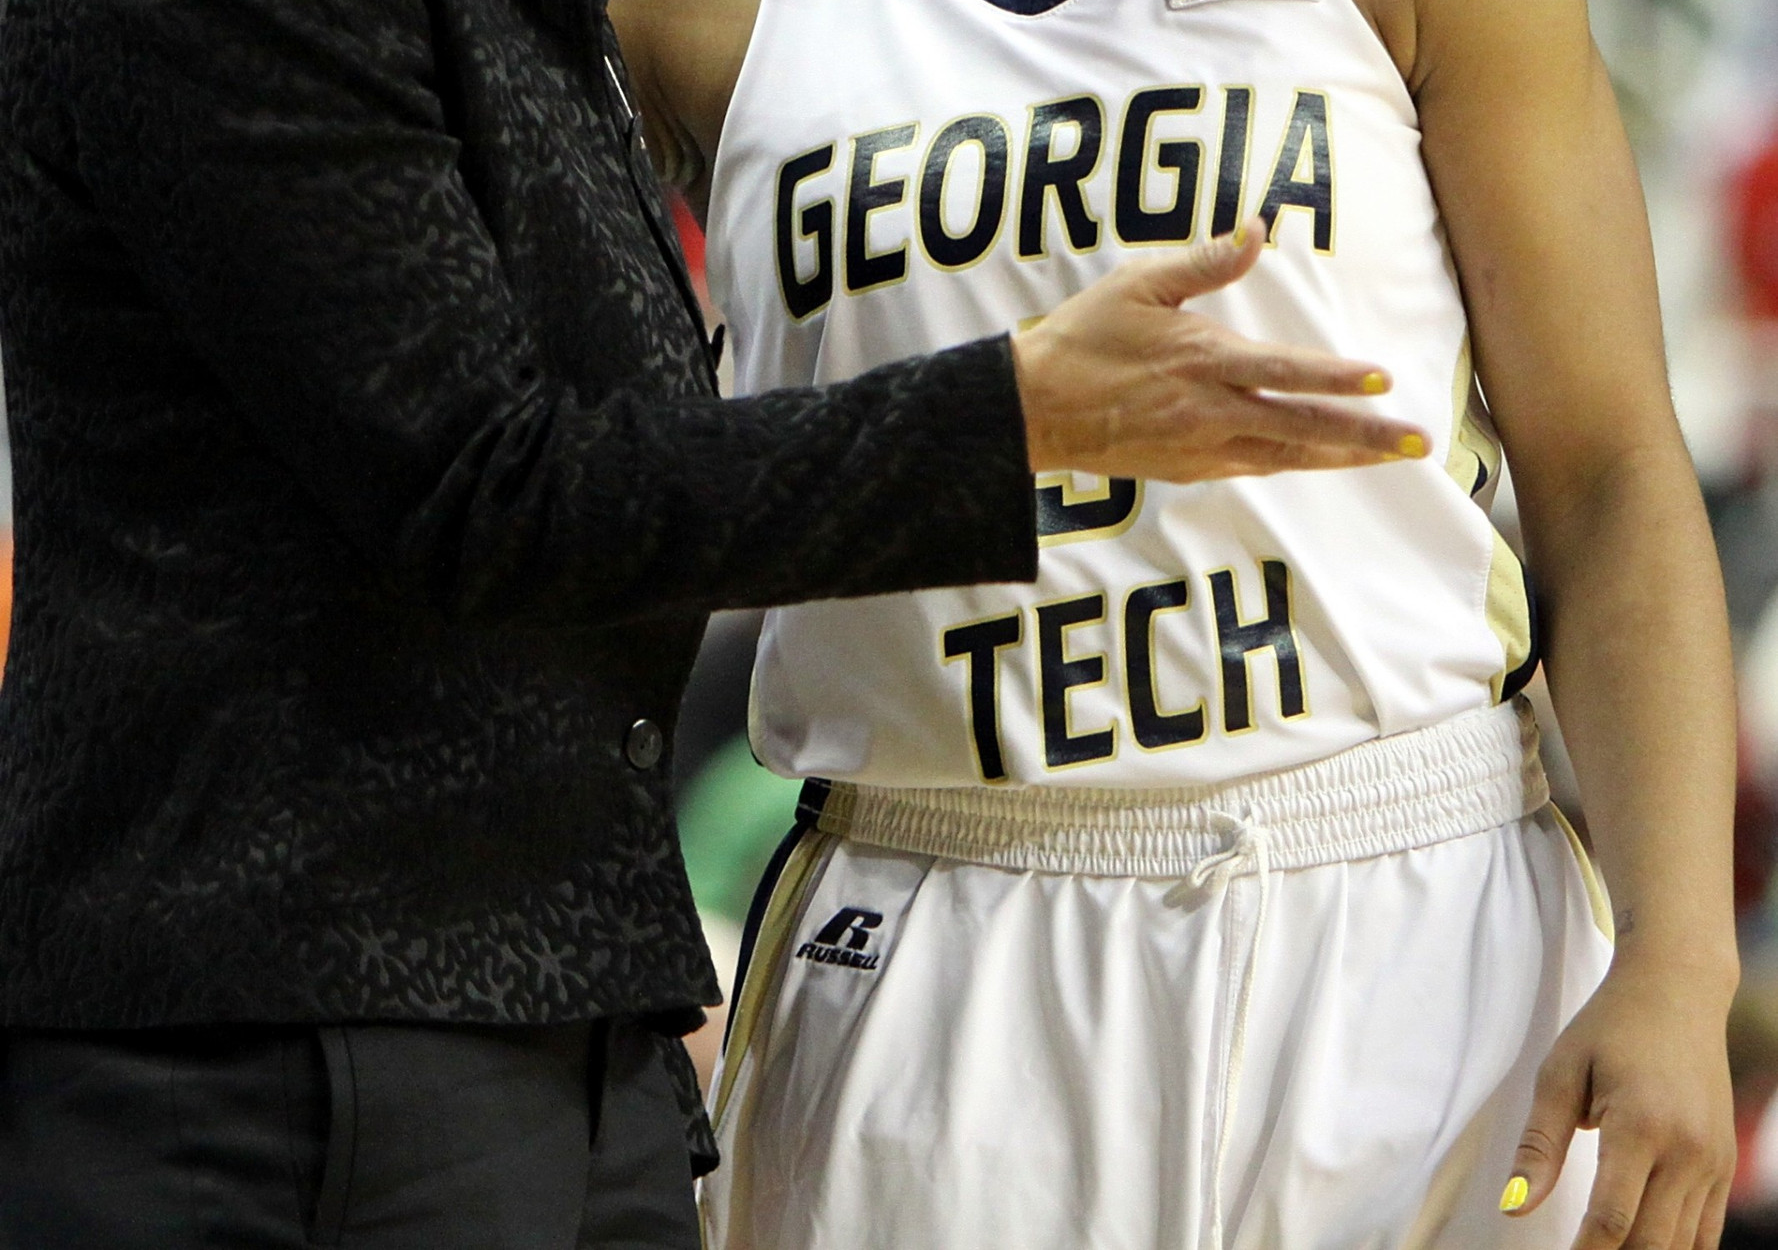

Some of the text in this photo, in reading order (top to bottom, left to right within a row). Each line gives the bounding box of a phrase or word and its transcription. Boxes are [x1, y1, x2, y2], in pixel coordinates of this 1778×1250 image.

[774, 84, 1336, 326] GEORGIA
[940, 557, 1310, 785] TECH
[796, 942, 880, 970] RUSSELL
